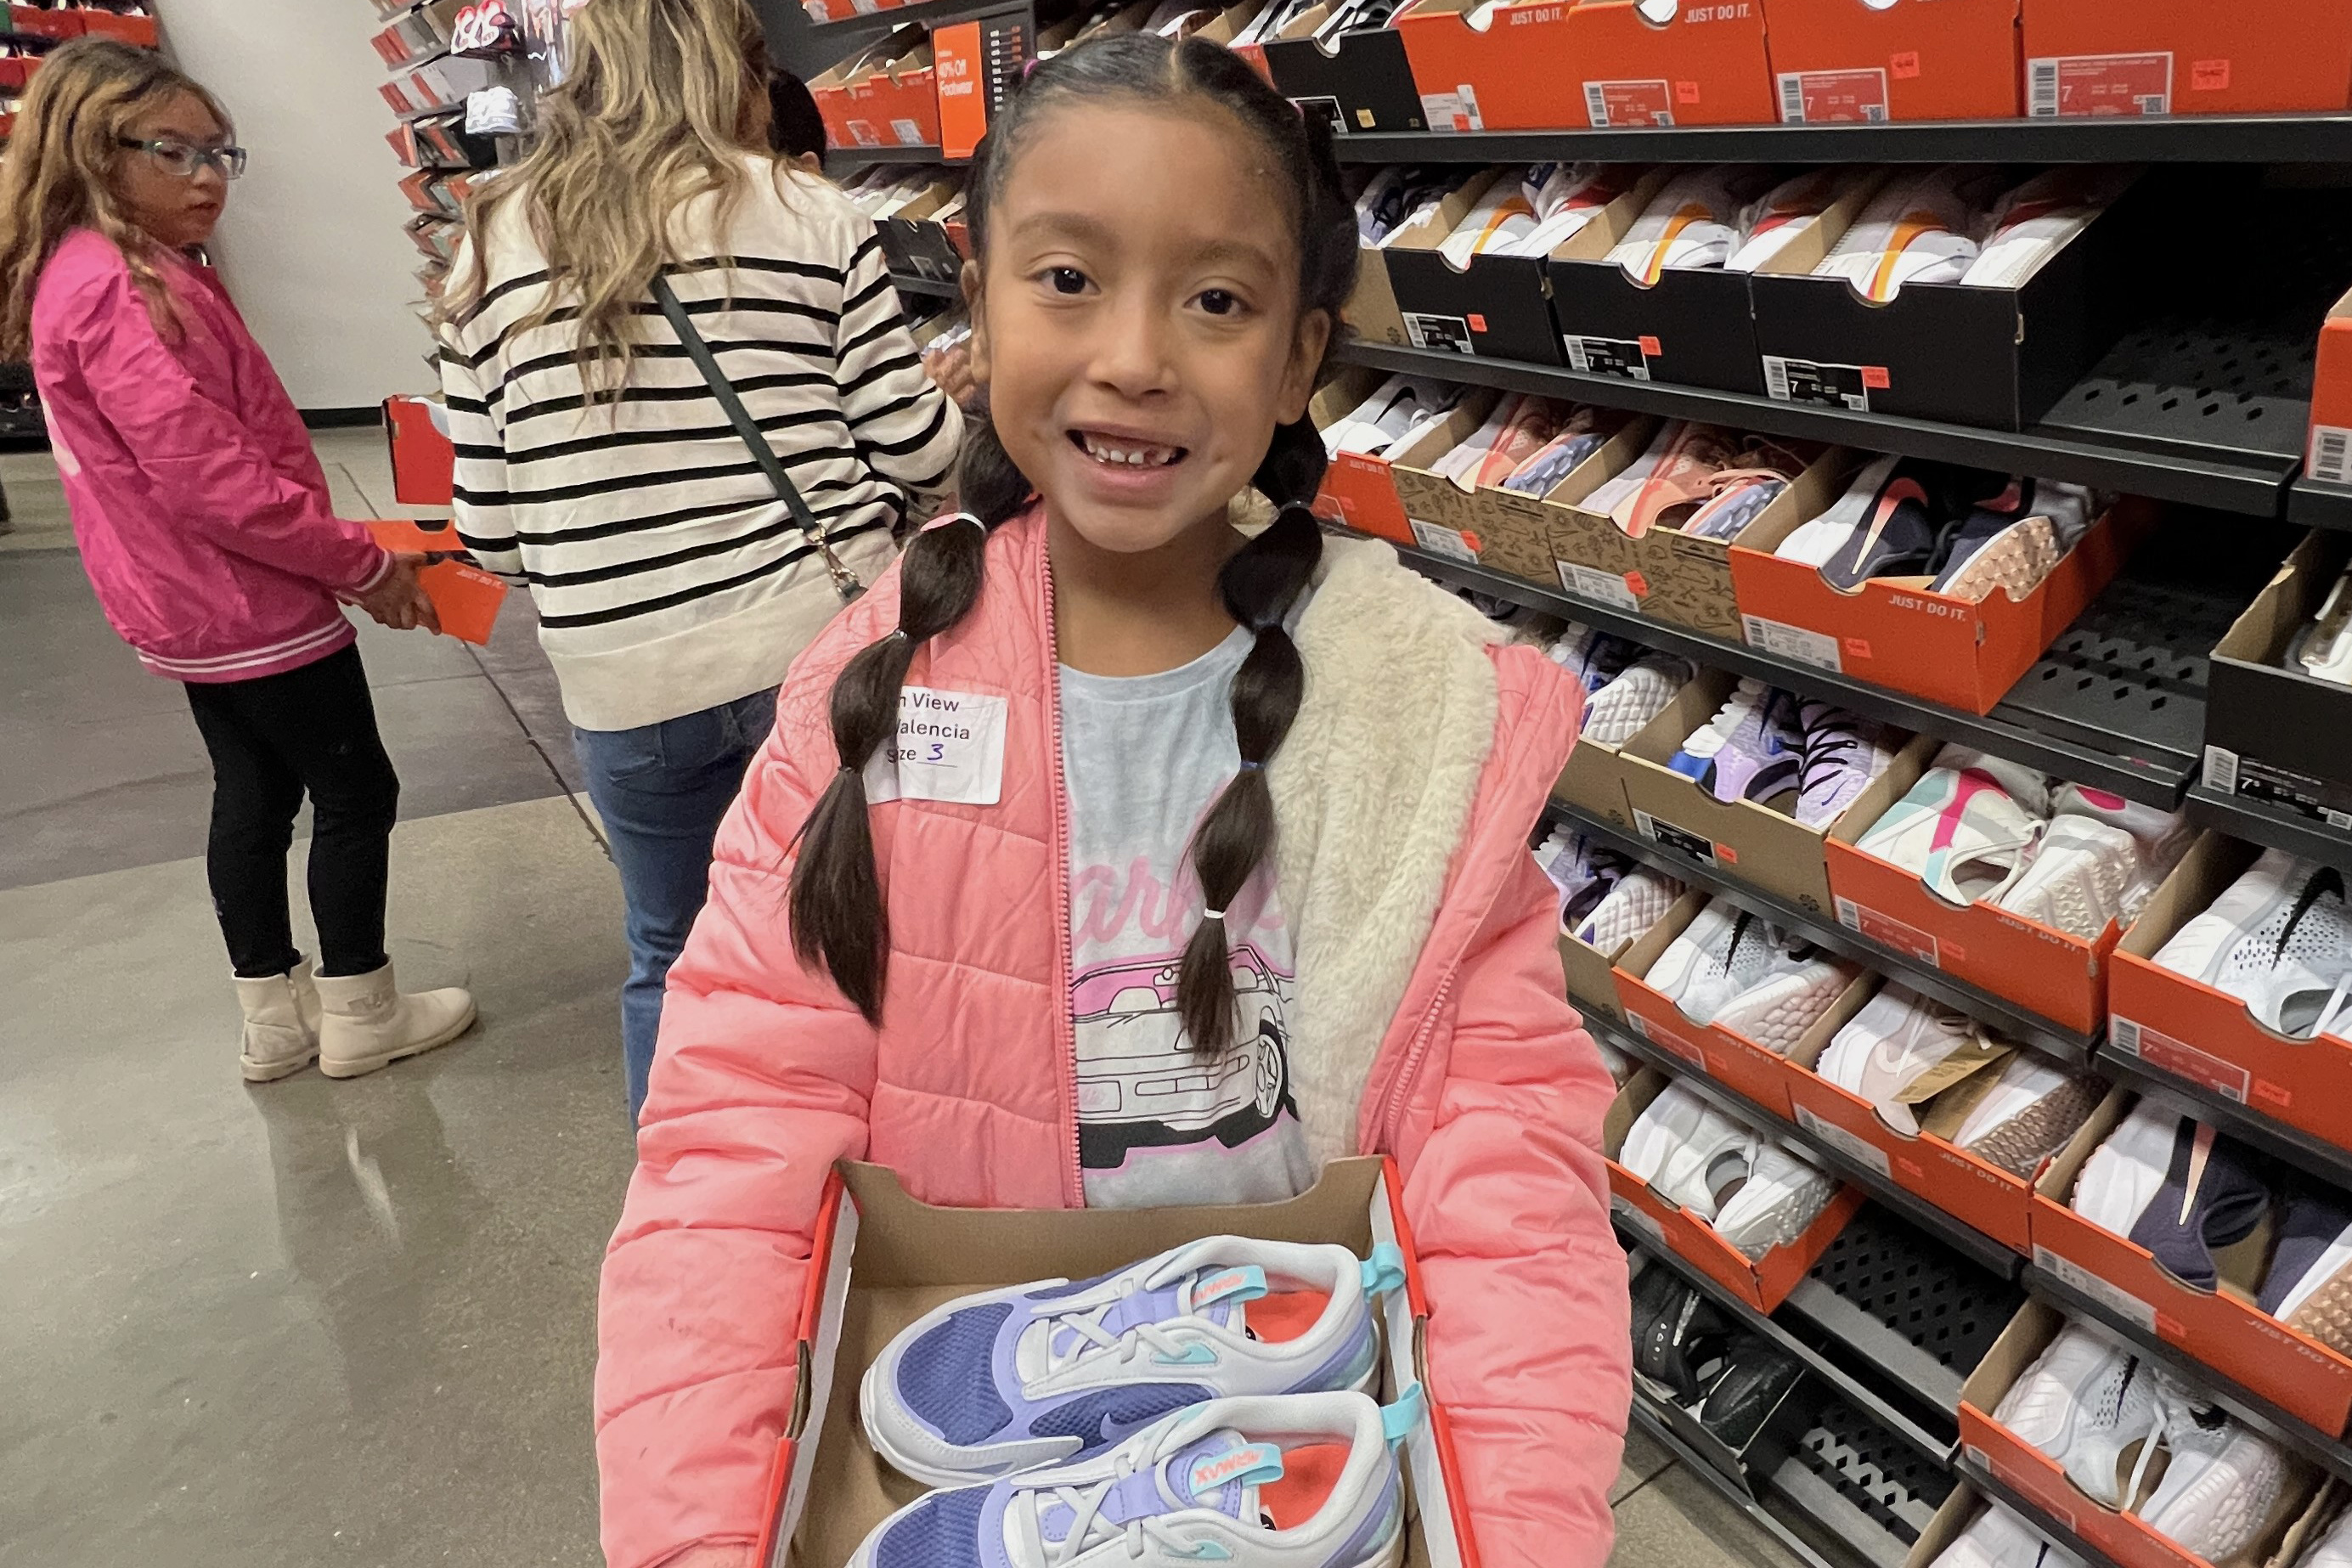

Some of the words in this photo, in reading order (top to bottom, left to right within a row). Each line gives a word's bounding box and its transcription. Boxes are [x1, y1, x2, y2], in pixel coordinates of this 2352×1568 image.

[1510, 11, 1532, 25] JUST
[1536, 8, 1549, 23] DO
[1684, 7, 1714, 23] JUST
[1717, 5, 1734, 20] DO
[1737, 3, 1751, 18] IT.
[2061, 86, 2073, 103] 7
[1606, 104, 1614, 118] 7
[1805, 96, 1814, 111] 7
[1588, 355, 1594, 367] 7
[1790, 381, 1799, 393] 7
[1888, 595, 1923, 611] JUST
[1927, 602, 1947, 617] DO
[1950, 608, 1966, 622] IT.
[912, 691, 960, 712] View
[927, 743, 945, 761] 3
[1997, 916, 2034, 933] JUST
[2038, 931, 2061, 945] DO
[1939, 1153, 1973, 1171] JUST
[1977, 1170, 1997, 1183] DO
